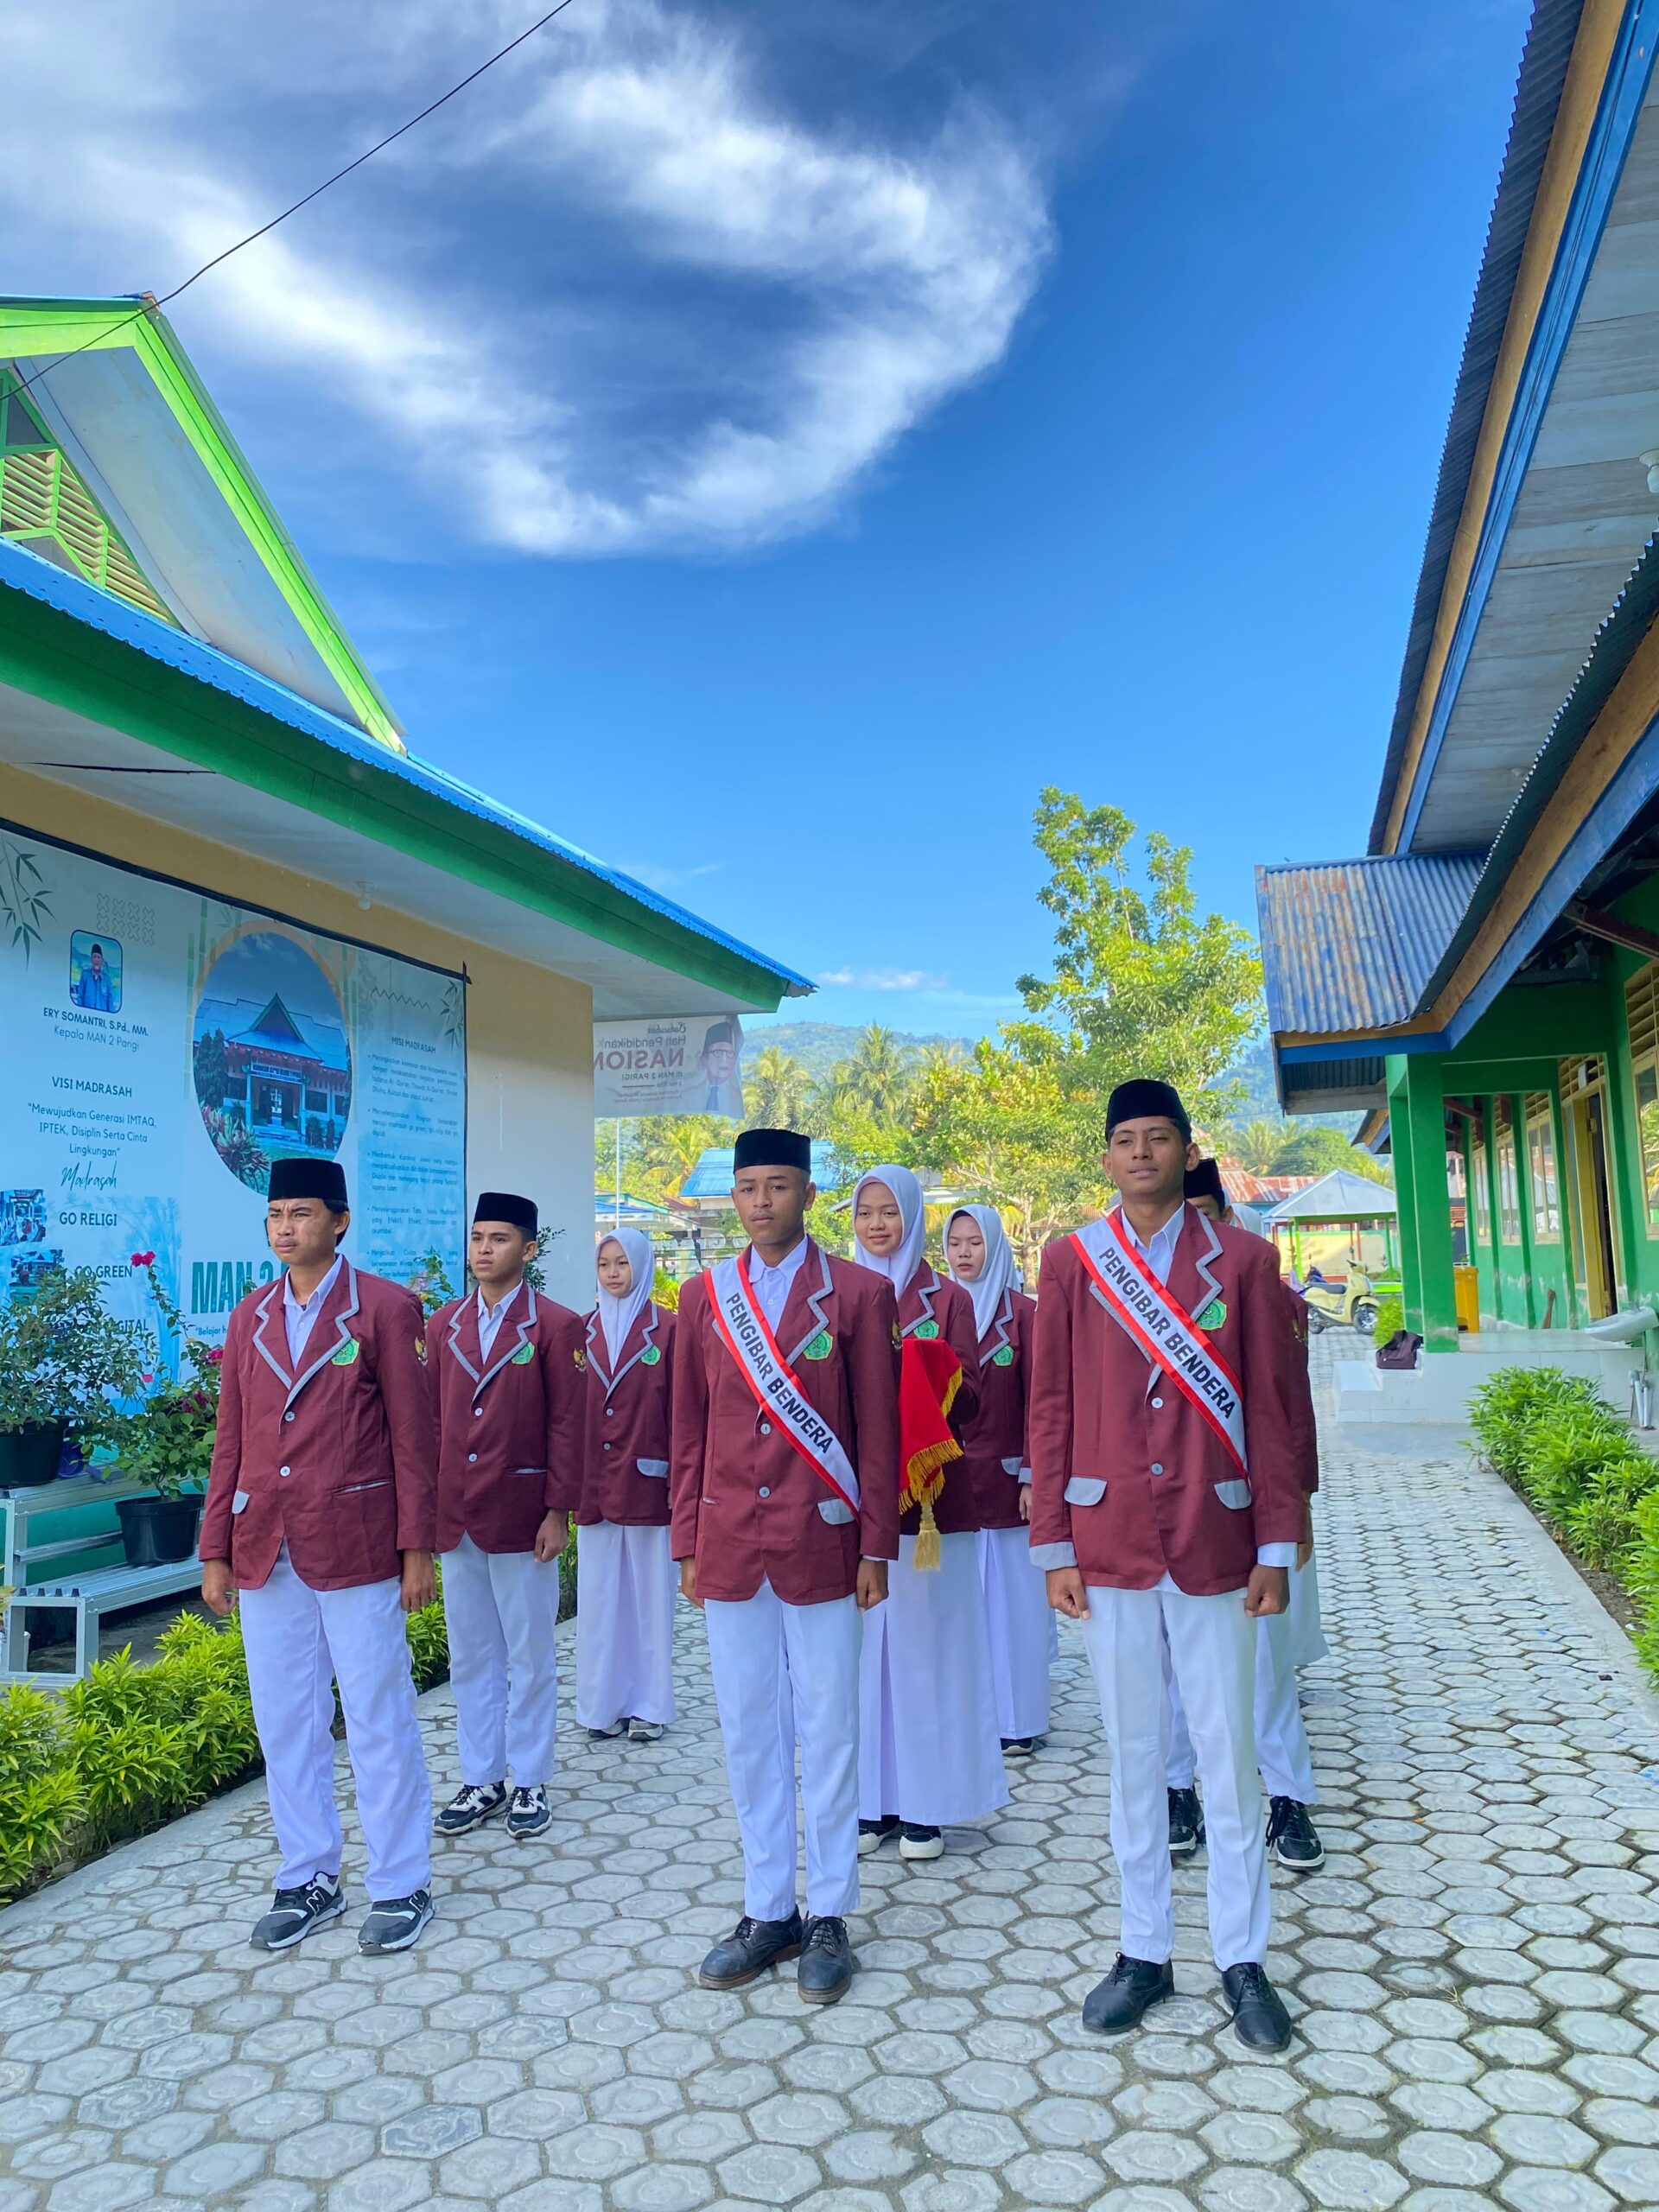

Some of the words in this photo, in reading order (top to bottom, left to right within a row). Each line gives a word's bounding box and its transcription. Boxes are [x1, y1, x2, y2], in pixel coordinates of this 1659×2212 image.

[43, 1007, 60, 1020] ERY
[61, 1011, 108, 1030] SOMANTRI,
[131, 1025, 149, 1037] MM.
[54, 1025, 85, 1042] Kepala
[86, 1031, 107, 1045] MAN
[109, 1035, 115, 1046] 2
[117, 1038, 140, 1052] Parigi
[52, 1077, 73, 1090] VISI
[75, 1079, 133, 1098] MADRASAH
[39, 1122, 69, 1136] IPTEK,
[72, 1125, 101, 1140] Disiplin
[103, 1129, 125, 1141] Serta
[127, 1131, 148, 1143] Cinta
[89, 1110, 125, 1124] Generasi
[127, 1115, 157, 1128] IMTAQ,
[61, 1160, 118, 1192] Madrasah
[60, 1212, 77, 1225] GO
[80, 1212, 118, 1226] RELIGI
[96, 1265, 132, 1278] GREEN
[191, 1262, 252, 1314] MAN
[1099, 1246, 1171, 1336] PENGIBAR
[1164, 1332, 1237, 1419] BENDERA
[726, 1292, 773, 1380] PENGIBAR
[767, 1377, 834, 1453] BENDERA
